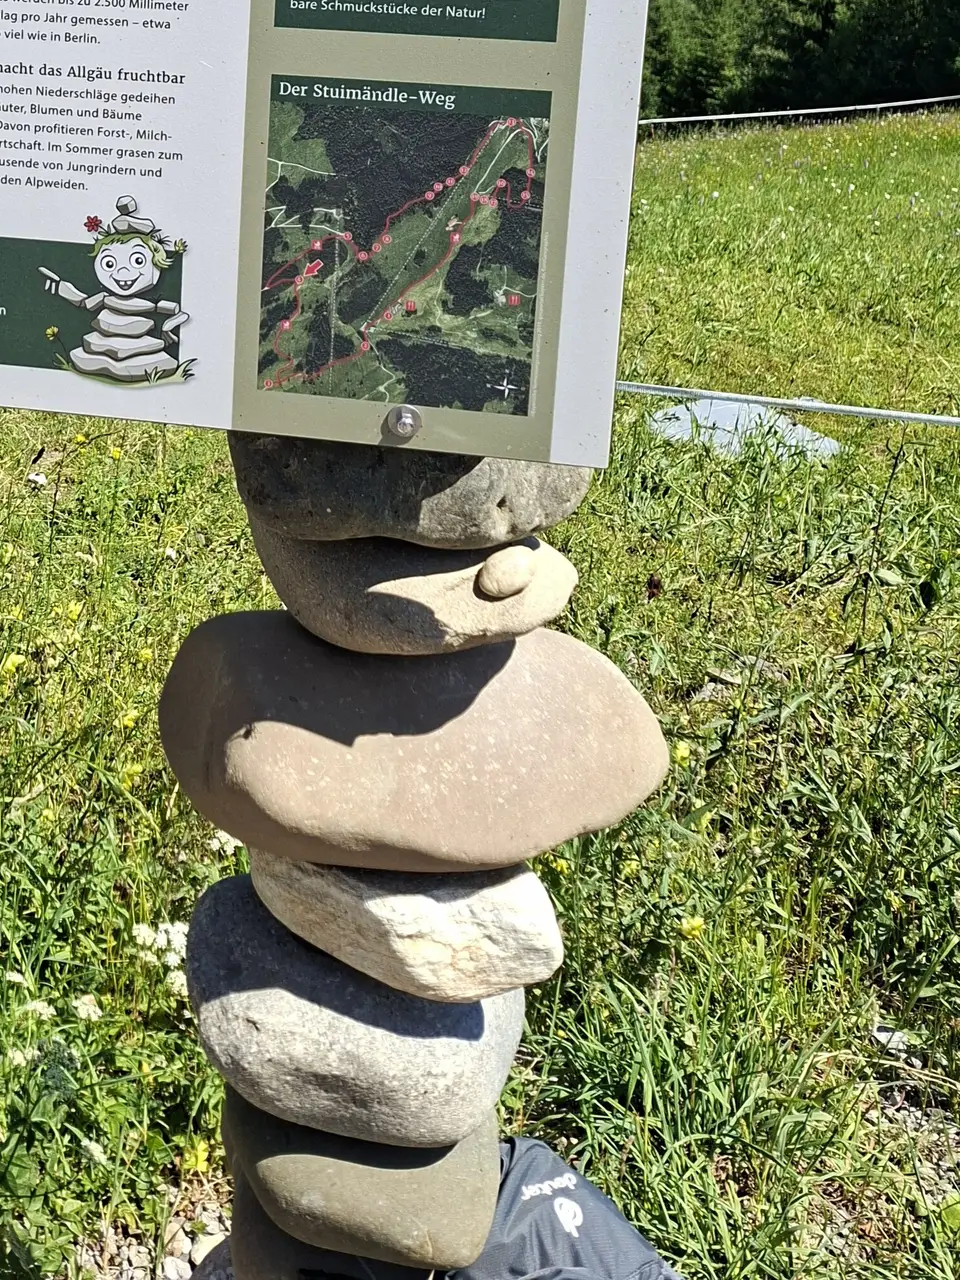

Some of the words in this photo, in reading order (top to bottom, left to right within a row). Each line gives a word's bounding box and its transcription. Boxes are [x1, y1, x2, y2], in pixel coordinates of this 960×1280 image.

[3, 28, 24, 40] viel
[26, 30, 47, 41] wie
[50, 31, 61, 42] in
[64, 31, 100, 44] Berlin.
[38, 63, 62, 77] das
[66, 65, 112, 82] Allgäu
[117, 67, 185, 84] fruchtbar
[278, 81, 308, 96] Der
[312, 83, 456, 110] Stuimändle-Weg
